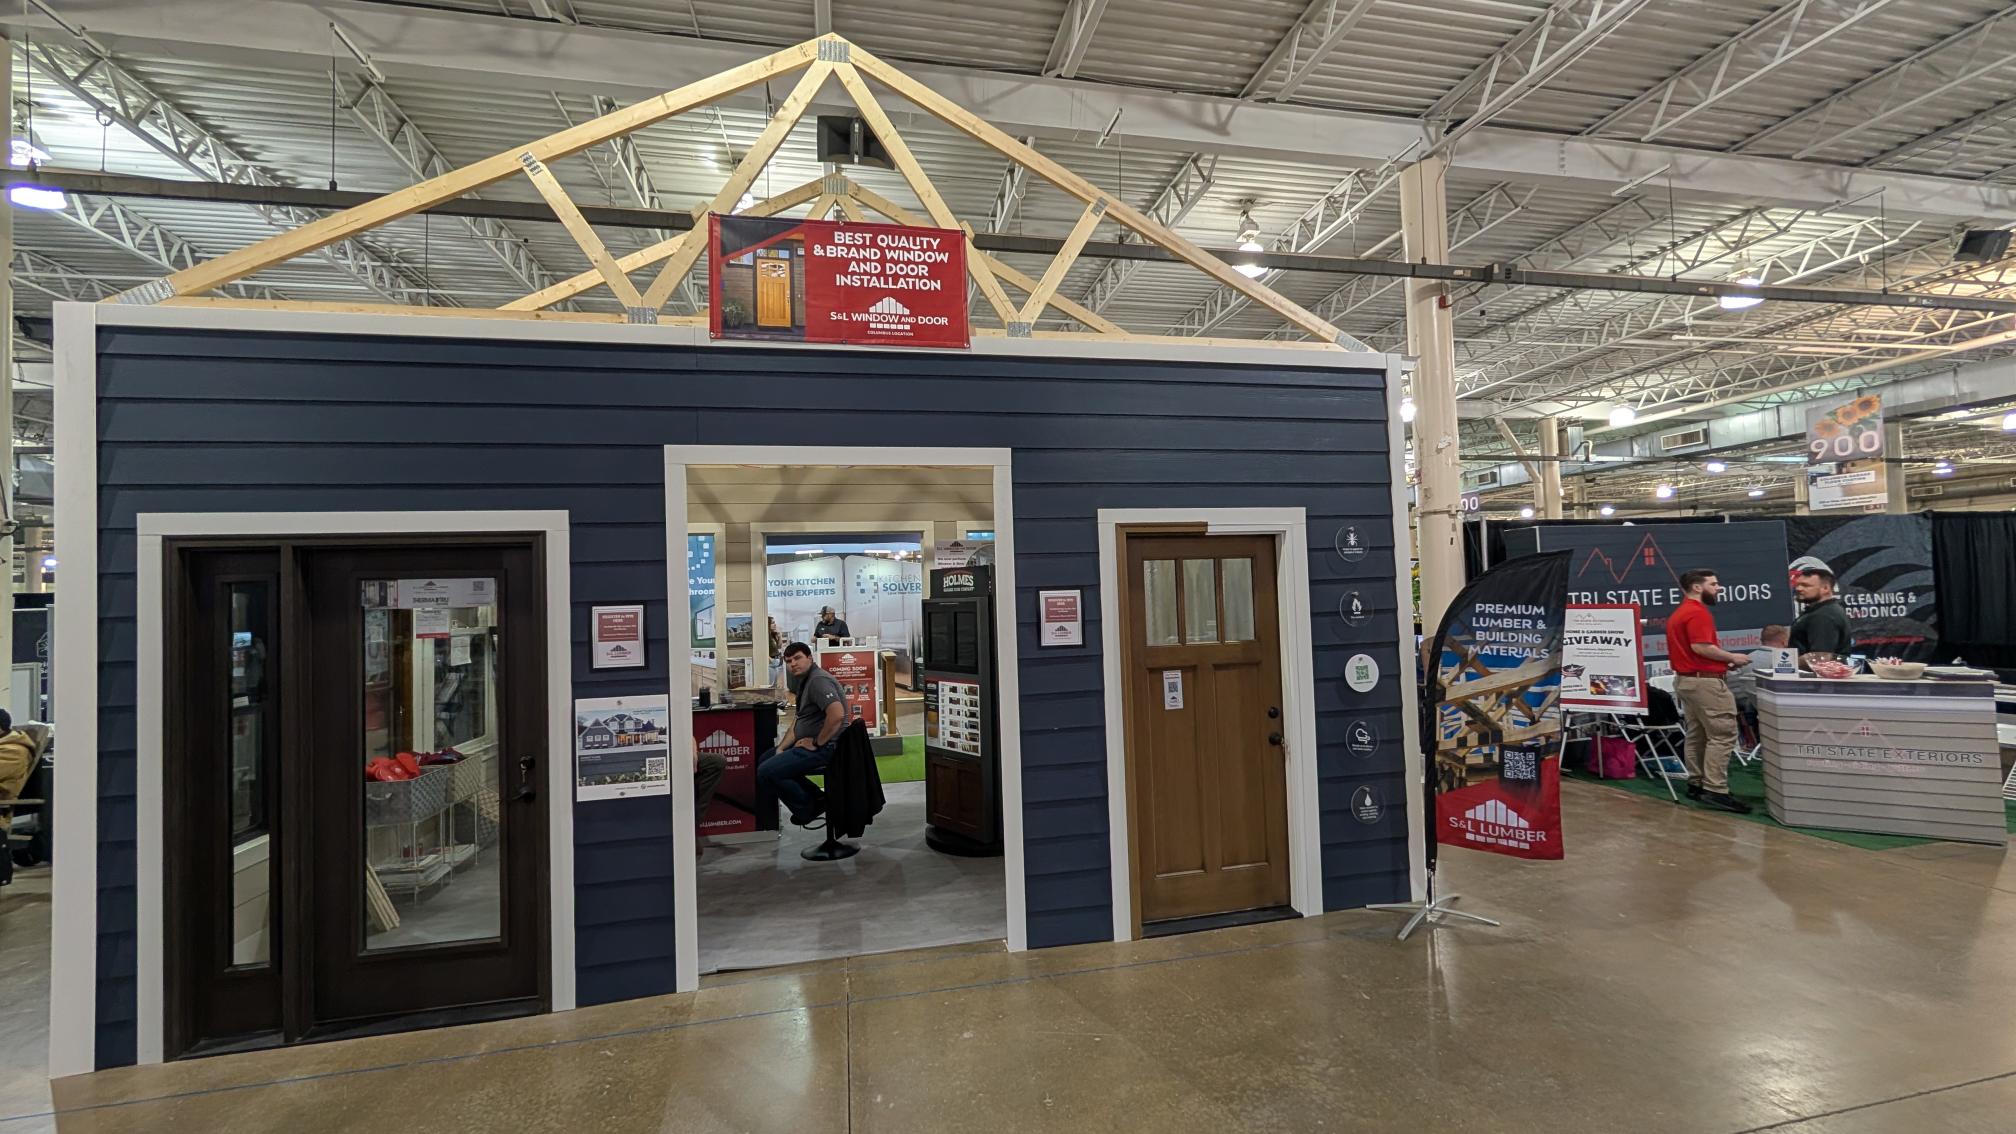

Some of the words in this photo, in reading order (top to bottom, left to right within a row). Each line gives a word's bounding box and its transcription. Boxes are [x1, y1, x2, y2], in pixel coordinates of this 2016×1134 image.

[834, 231, 872, 245] BEST
[877, 234, 940, 249] QUALITY
[885, 249, 949, 263] WINDOW
[848, 261, 881, 274] AND
[886, 263, 929, 276] DOOR
[835, 274, 941, 291] INSTALLATION
[830, 311, 849, 321] S&L
[851, 313, 899, 323] WINDOW
[918, 316, 949, 325] DOOR
[1810, 430, 1880, 460] 900
[796, 577, 835, 586] KITCHEN
[943, 574, 974, 588] HOLMES
[796, 588, 836, 597] EXPERTS
[1568, 591, 1598, 605] TRI
[1606, 588, 1663, 606] STATE
[1907, 592, 1917, 603] &
[1475, 603, 1545, 616] PREMIUM
[1472, 616, 1532, 629] LUMBER
[1536, 620, 1547, 629] &
[1475, 630, 1542, 644] BUILDING
[1562, 635, 1633, 648] GIVEAWAY
[1468, 644, 1549, 659] MATERIALS
[1827, 745, 1876, 758] STATE
[1884, 750, 1984, 764] EXTERIORS
[1448, 816, 1475, 832] S&L
[1480, 823, 1547, 842] LUMBER
